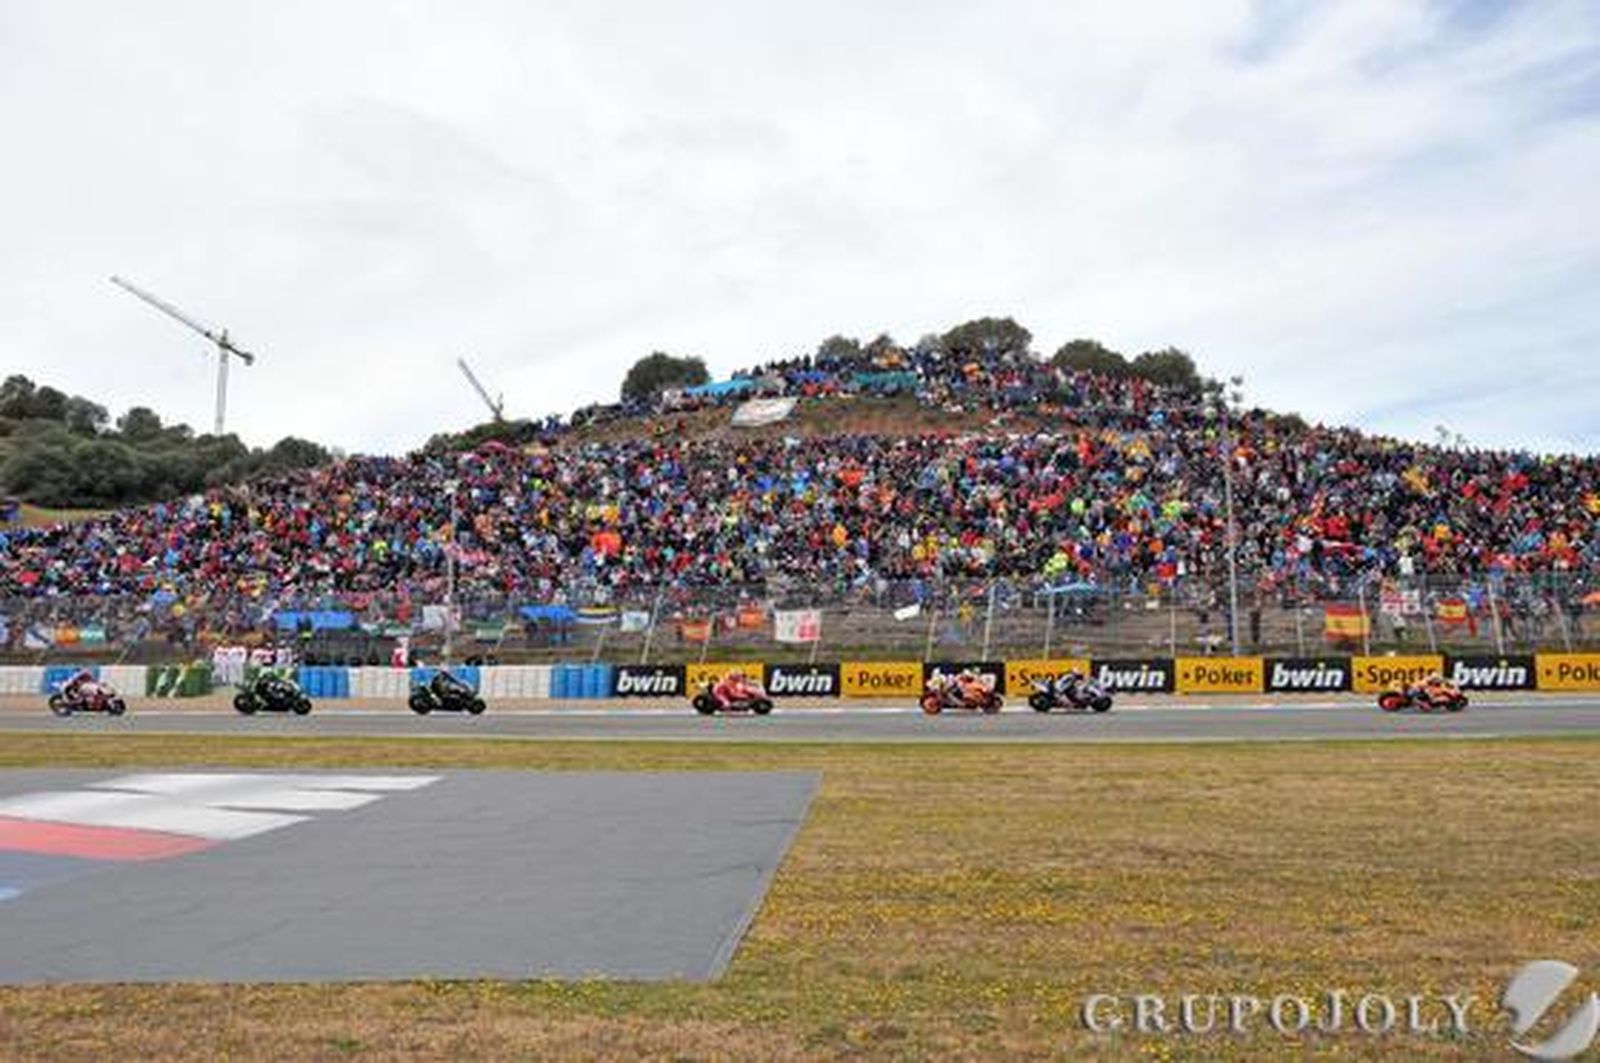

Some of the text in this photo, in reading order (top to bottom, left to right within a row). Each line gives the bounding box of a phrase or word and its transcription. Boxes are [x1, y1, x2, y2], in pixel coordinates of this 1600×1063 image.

[616, 669, 678, 692] bwin
[769, 669, 833, 692] bwin
[858, 669, 914, 688] Poker
[1099, 665, 1166, 688] bwin
[1193, 665, 1254, 685] Poker
[1271, 662, 1345, 687] bwin
[1453, 660, 1527, 686] bwin
